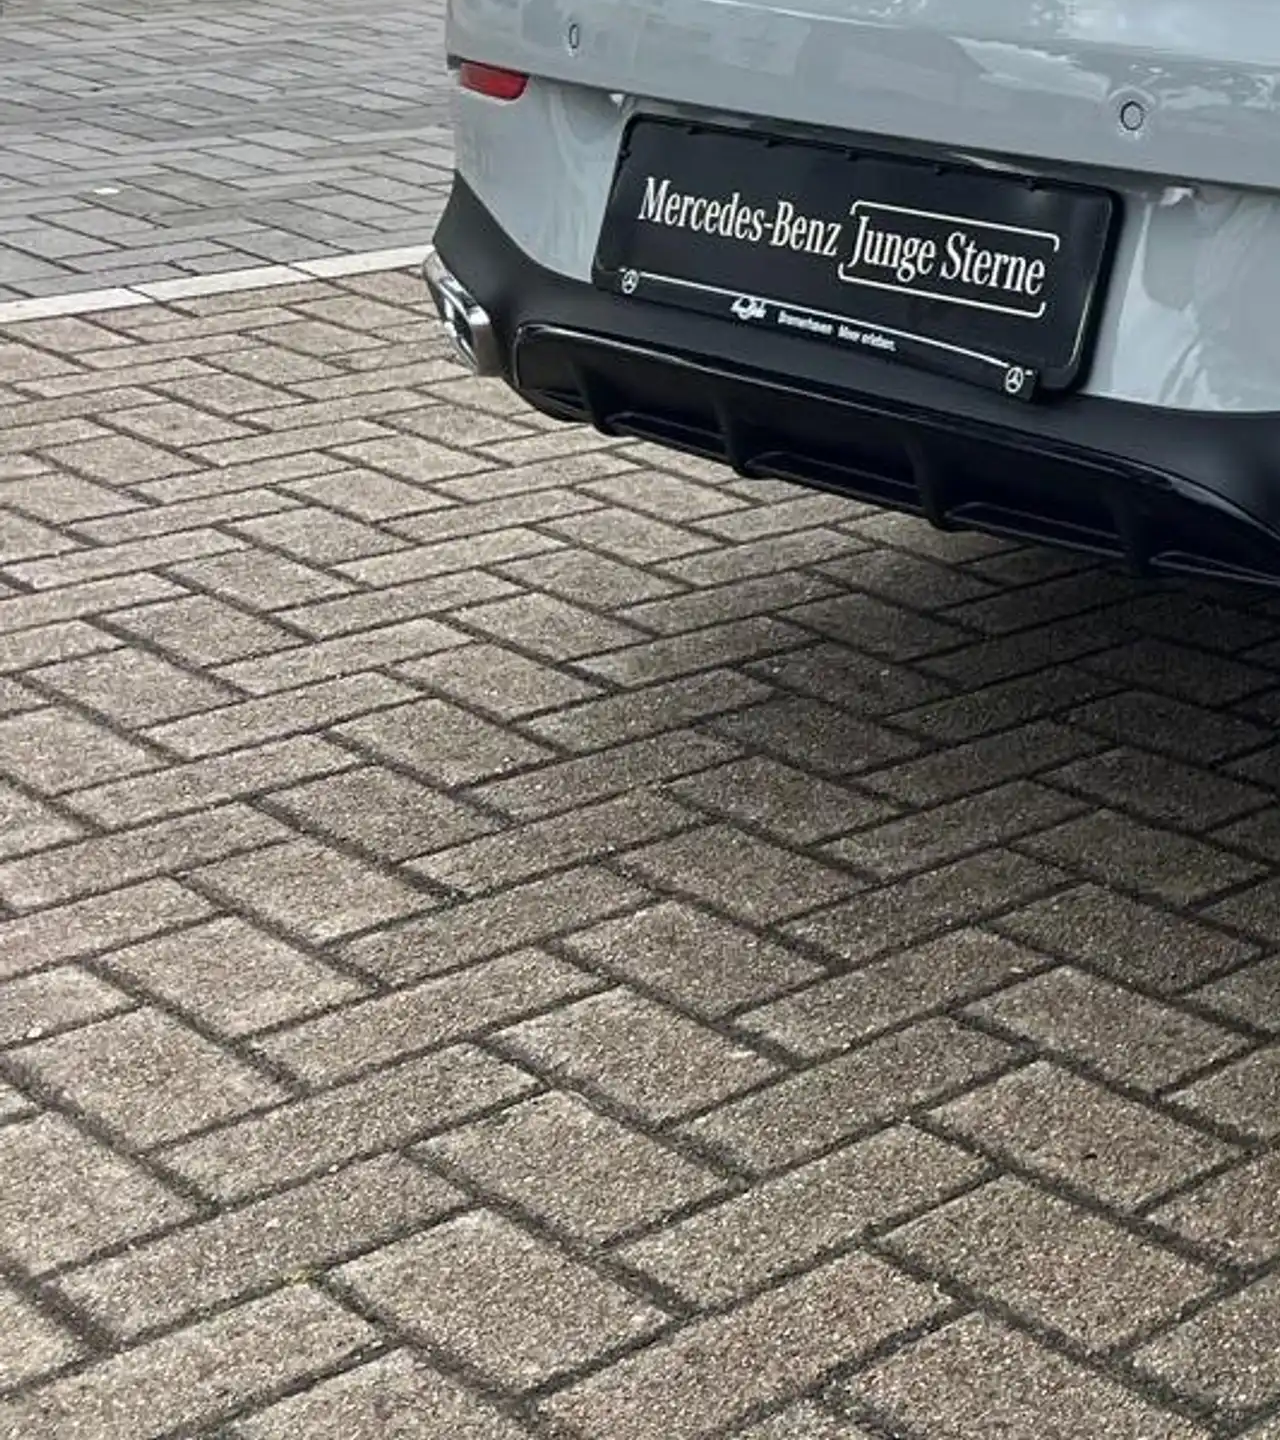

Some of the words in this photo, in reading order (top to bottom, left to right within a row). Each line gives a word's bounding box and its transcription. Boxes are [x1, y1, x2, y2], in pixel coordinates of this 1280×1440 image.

[637, 176, 843, 256] Mercedes-Benz
[848, 216, 936, 282] Junge
[939, 231, 1046, 295] Sterne
